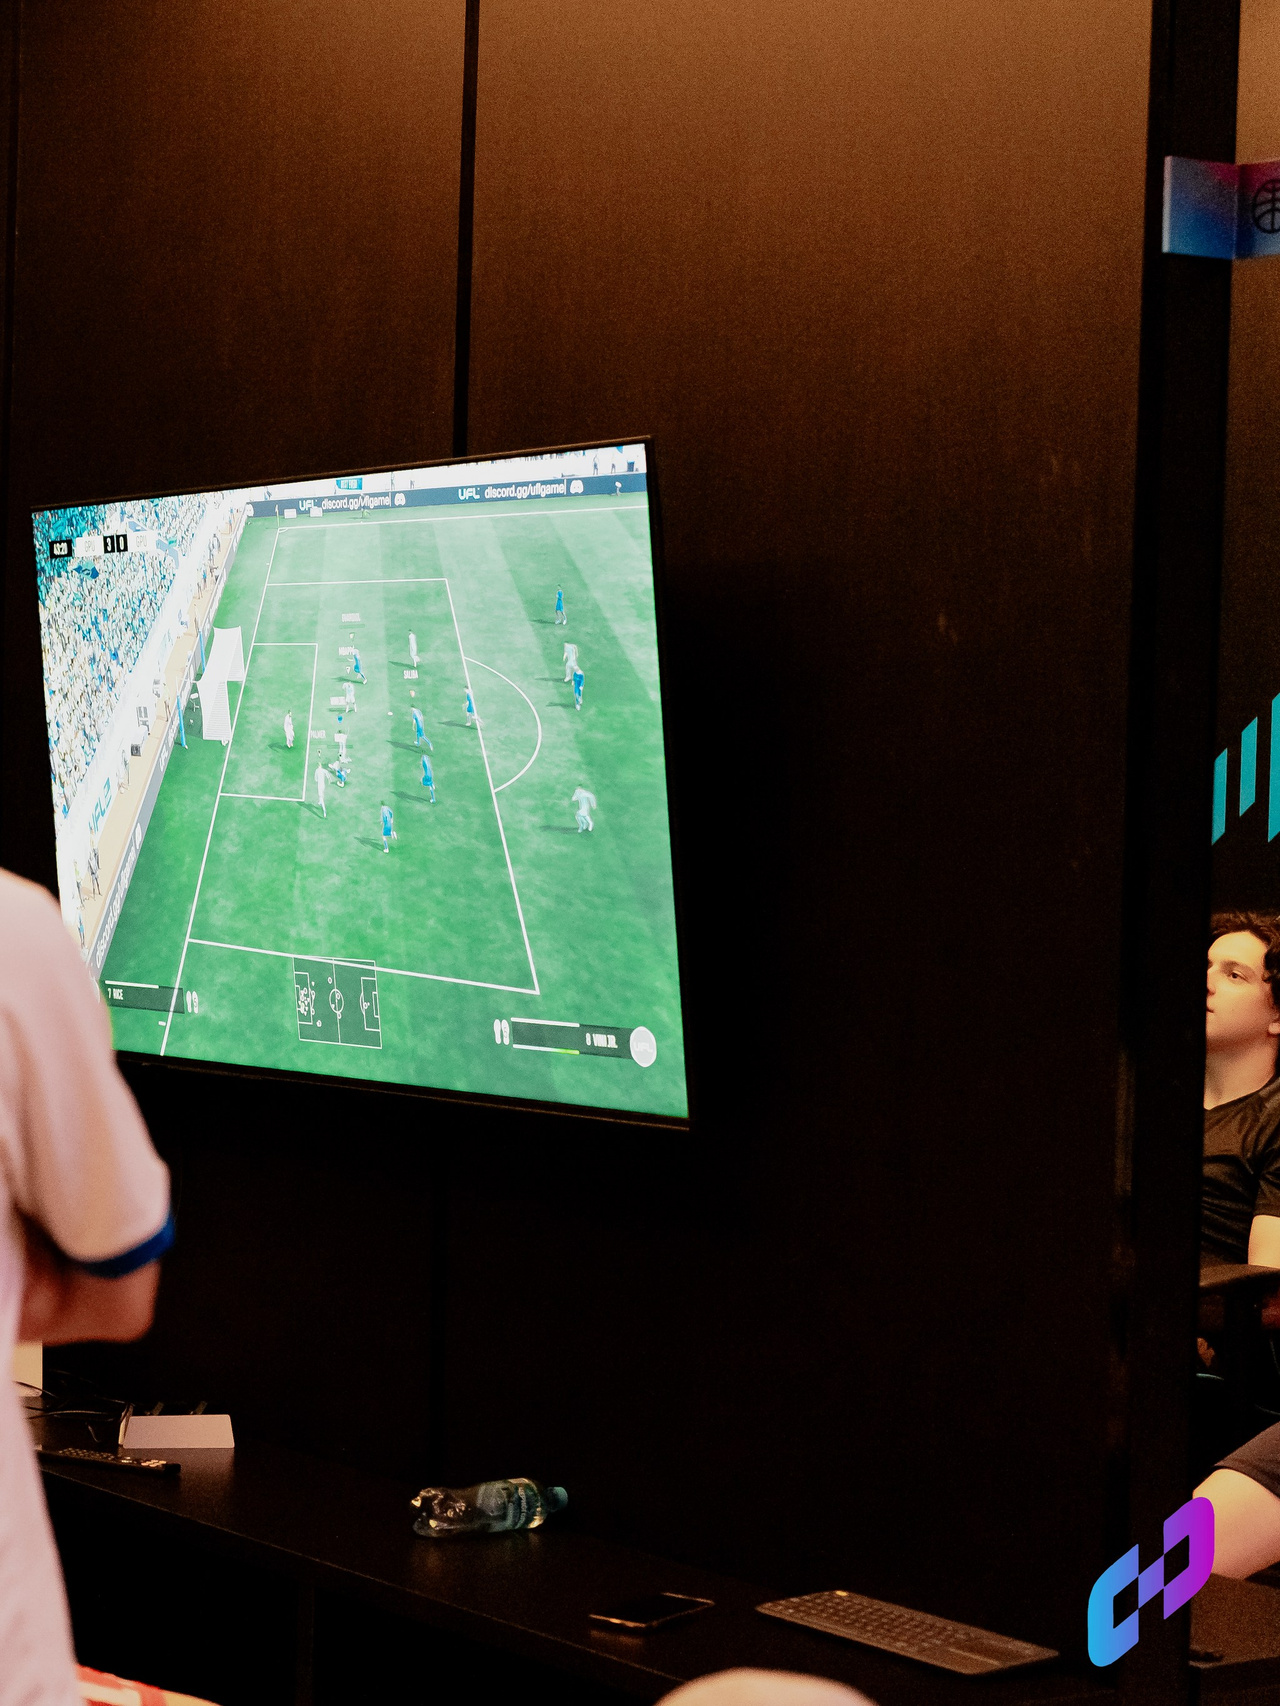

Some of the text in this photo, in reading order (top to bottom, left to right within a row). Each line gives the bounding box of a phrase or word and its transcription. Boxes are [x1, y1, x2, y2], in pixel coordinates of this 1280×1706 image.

[458, 479, 565, 500] UFL discord.gg/uflgame
[106, 537, 112, 551] 3
[119, 537, 125, 550] 0
